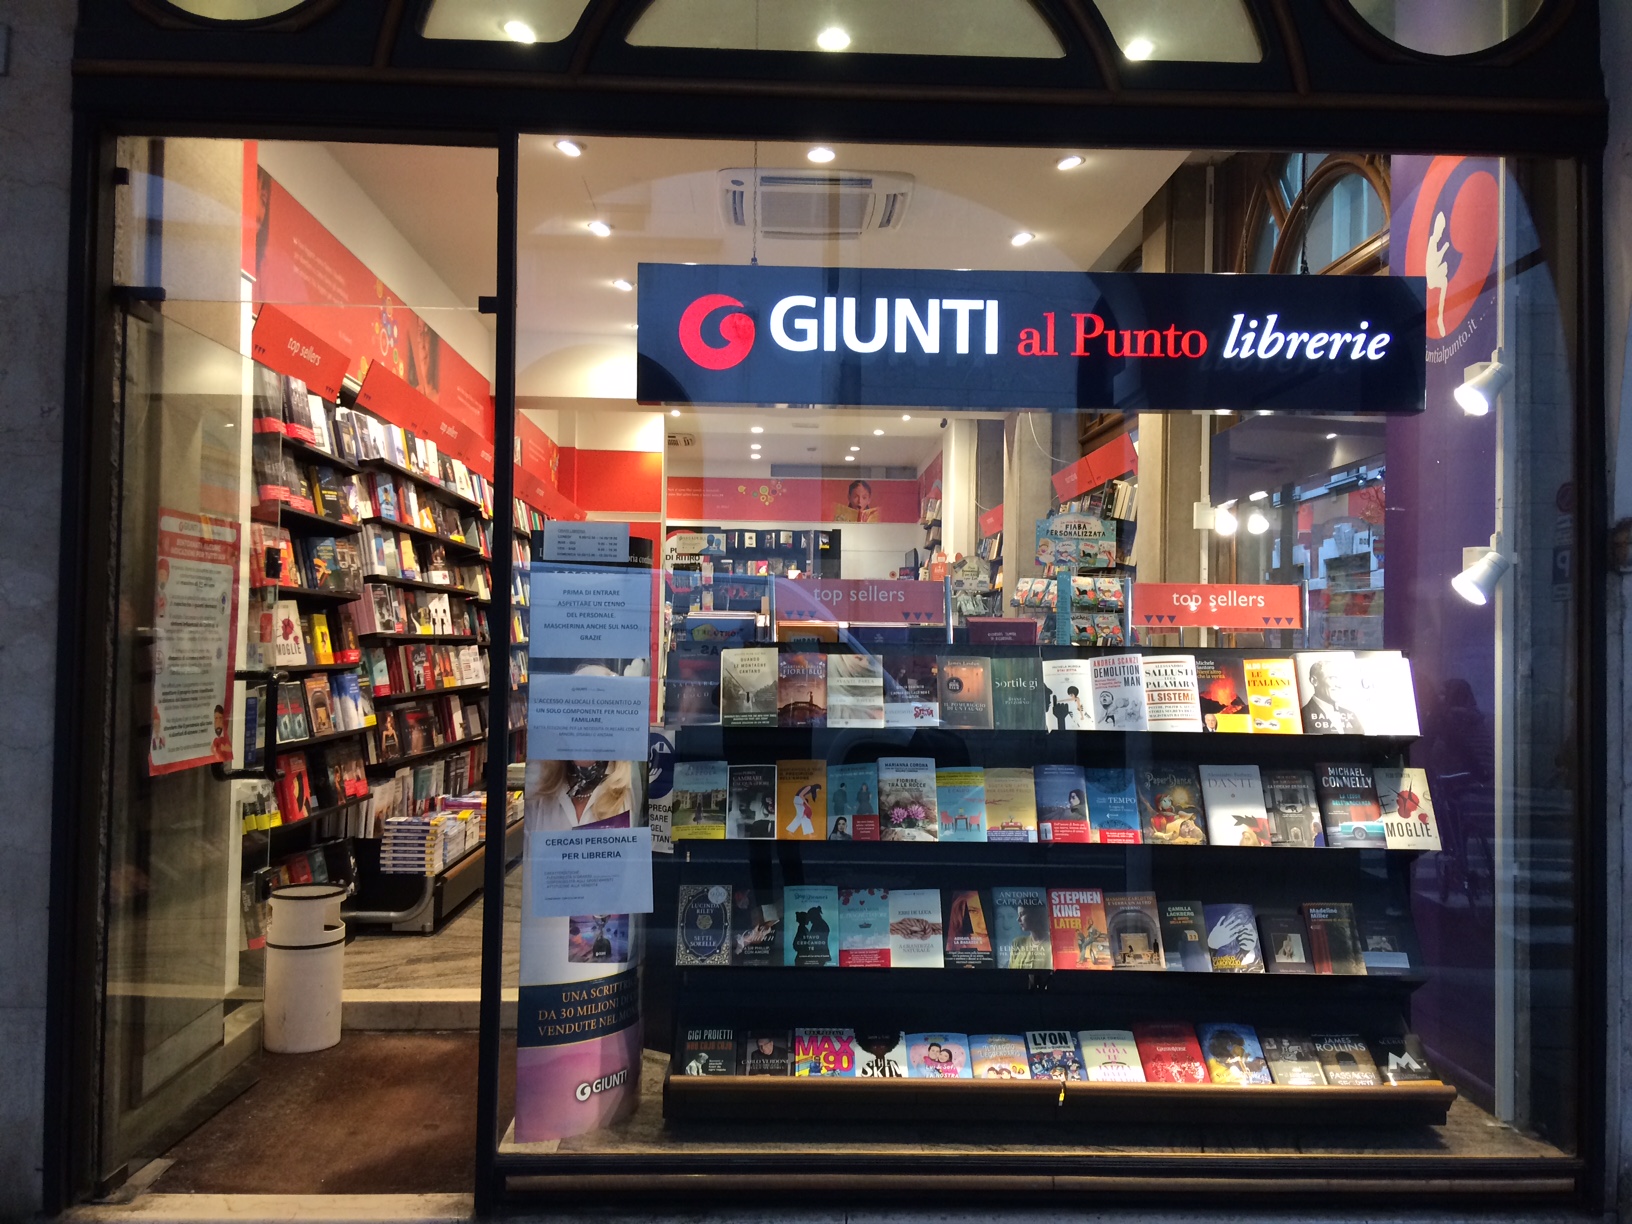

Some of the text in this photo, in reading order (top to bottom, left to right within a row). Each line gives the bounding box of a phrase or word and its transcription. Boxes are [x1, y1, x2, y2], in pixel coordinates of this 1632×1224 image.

[770, 295, 1390, 361] GIUNTI al Punto librerie
[287, 337, 322, 367] top sellers
[1046, 529, 1106, 538] PERSONALIZZATA
[675, 554, 701, 562] RITIRO
[813, 585, 905, 605] top sellers
[1173, 590, 1265, 610] top sellers
[275, 643, 302, 656] MOGLIE
[1093, 656, 1139, 668] ANDREA SCANZI
[1093, 665, 1141, 679] DEMOLITION
[1144, 668, 1194, 678] SALLUSTI
[994, 677, 1038, 693] Sortilegi
[1123, 676, 1141, 687] MAN
[1145, 680, 1195, 690] PALAMARA
[1146, 692, 1195, 702] IL SISTEMA
[952, 702, 987, 710] POMERIGGIO
[1311, 712, 1355, 720] BACK
[1327, 766, 1365, 777] MICHAEL
[1208, 778, 1255, 789] DANTE
[1322, 776, 1373, 789] CONNELLY
[1108, 796, 1136, 804] TEMPO
[1385, 822, 1433, 838] MOGLIE
[545, 835, 638, 846] CERCASI PERSONALE
[561, 850, 622, 860] PER LIBRERIA
[999, 891, 1039, 899] ANTONIO
[1051, 891, 1101, 904] STEPHEN
[995, 898, 1044, 906] CAPRARICA
[1053, 904, 1081, 918] KING
[1054, 917, 1082, 929] LATER
[562, 990, 588, 1003] UNA
[538, 999, 620, 1021] DA 30 MILIONI
[538, 1016, 618, 1036] VENDUTE NEL
[687, 1029, 733, 1041] GIGI PROIETTI
[1031, 1032, 1069, 1046] LYON
[795, 1035, 855, 1057] MAX
[1315, 1043, 1366, 1052] ROLLINS
[823, 1049, 856, 1072] 90
[1388, 1051, 1423, 1072] M
[860, 1058, 905, 1078] SKIN
[592, 1069, 629, 1094] GIUNTI
[1329, 1071, 1376, 1080] PASSAGGI
